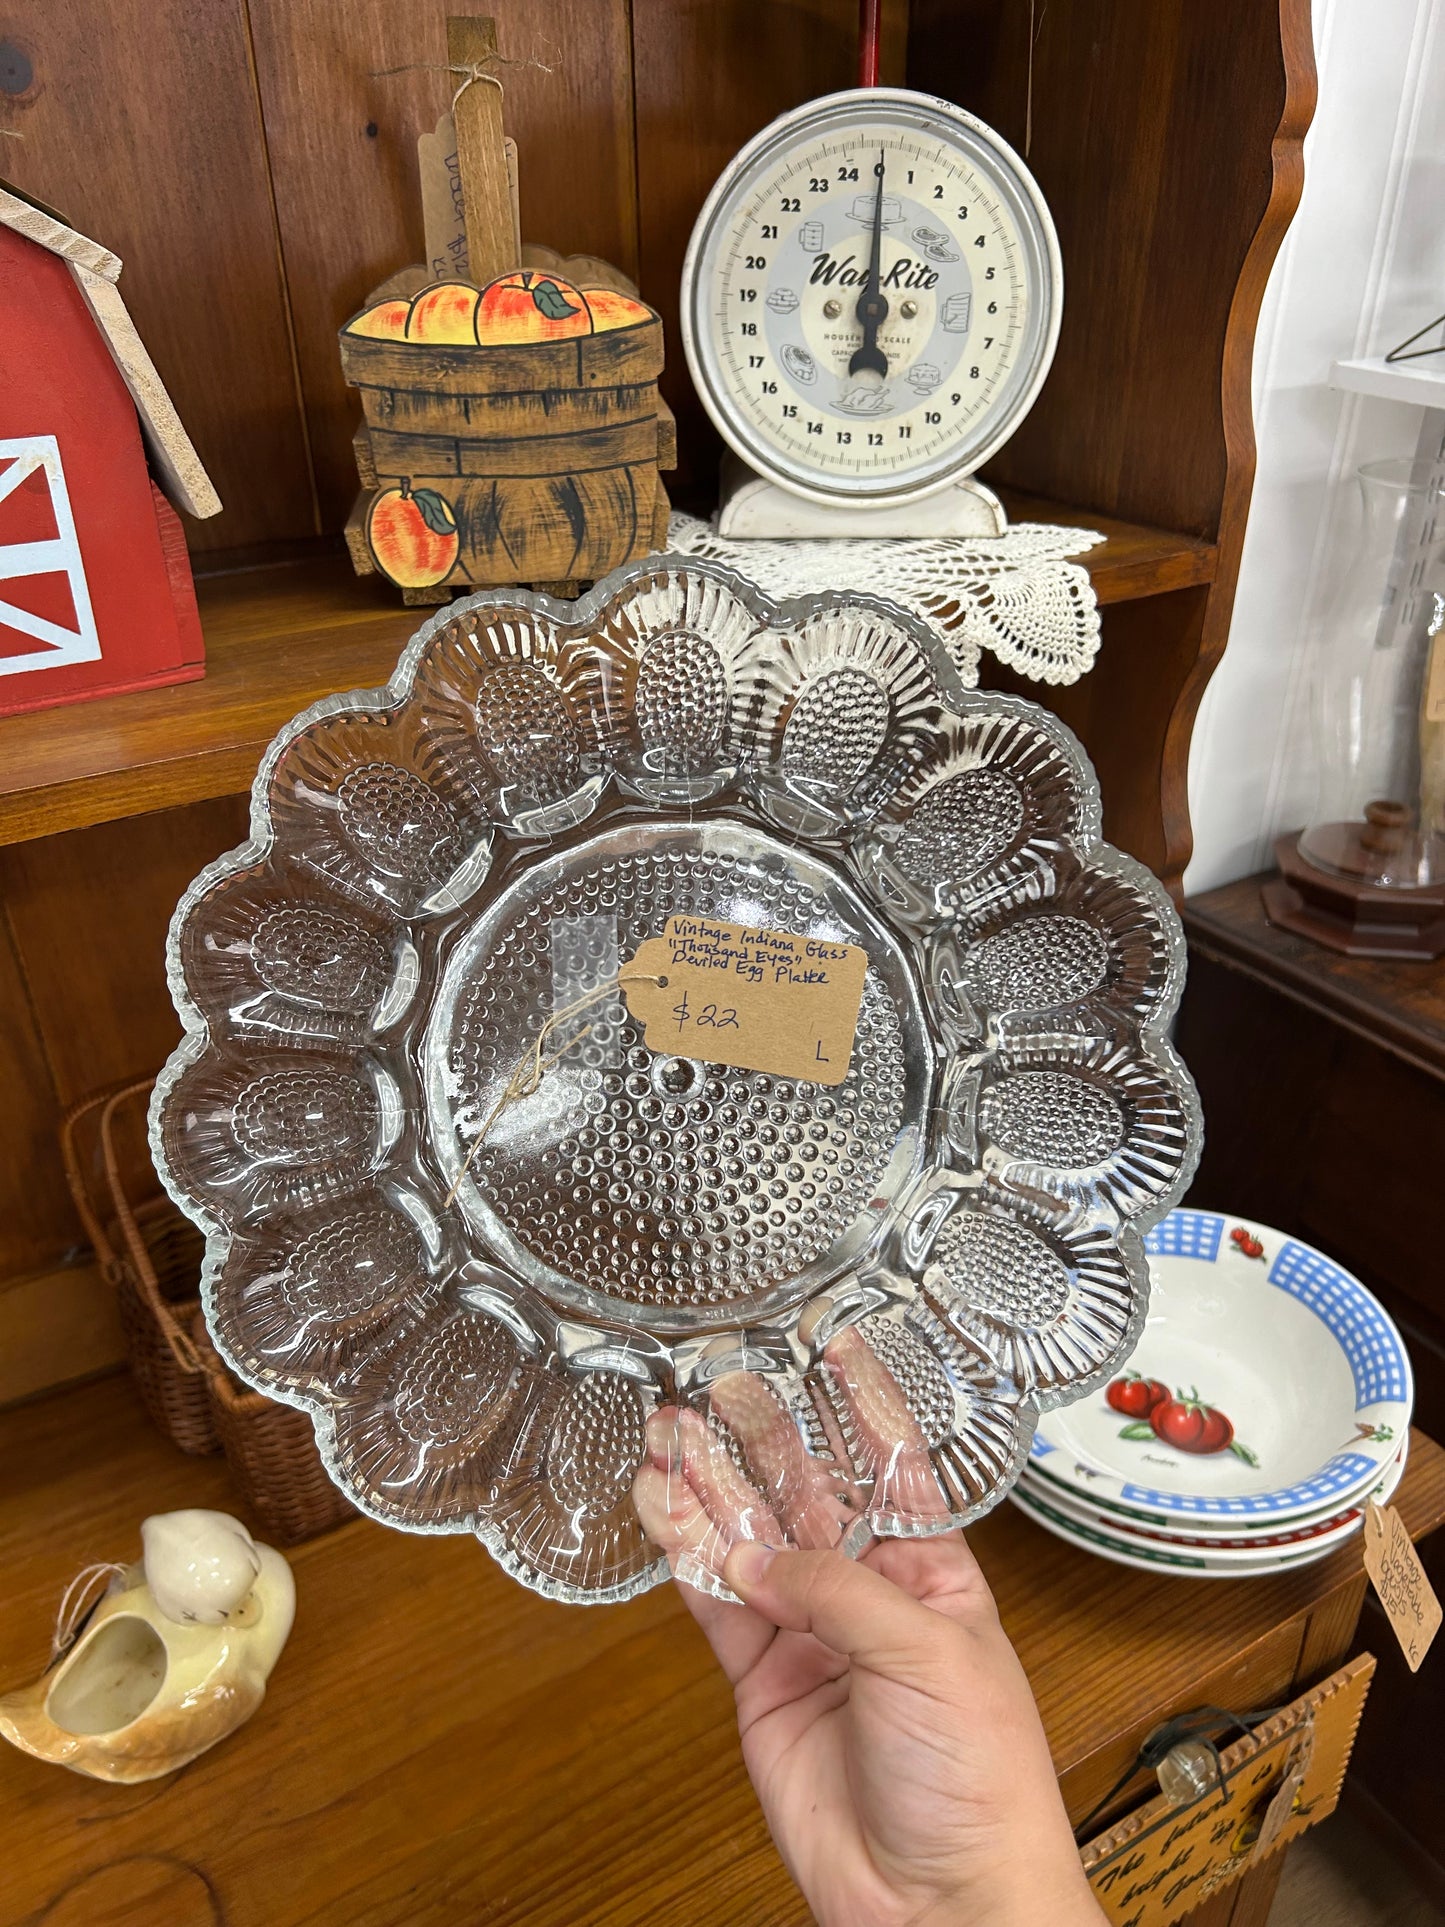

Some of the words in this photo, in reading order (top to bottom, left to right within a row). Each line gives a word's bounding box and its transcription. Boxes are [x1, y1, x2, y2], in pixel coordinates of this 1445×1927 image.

[837, 167, 859, 181] 24
[874, 162, 885, 178] 0
[907, 170, 914, 184] 1
[808, 178, 829, 192] 23
[933, 184, 944, 199] 2
[780, 198, 801, 212] 22
[957, 205, 968, 219] 3
[760, 225, 778, 239] 21
[974, 235, 986, 248] 4
[744, 255, 766, 270] 20
[985, 267, 996, 280] 5
[739, 288, 757, 302] 19
[986, 301, 997, 314] 6
[741, 322, 757, 336] 18
[884, 336, 911, 344] SCALE
[984, 337, 994, 349] 7
[748, 355, 765, 368] 17
[969, 366, 980, 379] 8
[761, 381, 778, 394] 16
[950, 393, 961, 406] 9
[782, 405, 798, 418] 15
[925, 411, 942, 424] 10
[806, 421, 823, 435] 14
[898, 426, 911, 438] 11
[836, 432, 852, 444] 13
[867, 433, 883, 446] 12
[674, 919, 731, 947] Vintage
[740, 930, 794, 952] Indiana
[805, 941, 849, 960] Glass
[669, 938, 748, 960] "Thousand
[672, 950, 729, 969] Deviled
[736, 960, 764, 982] Egg
[672, 991, 739, 1032] $22
[815, 1040, 829, 1062] L
[1391, 1514, 1422, 1590] Vintage
[1379, 1579, 1396, 1615] $15
[1096, 1852, 1146, 1893] The
